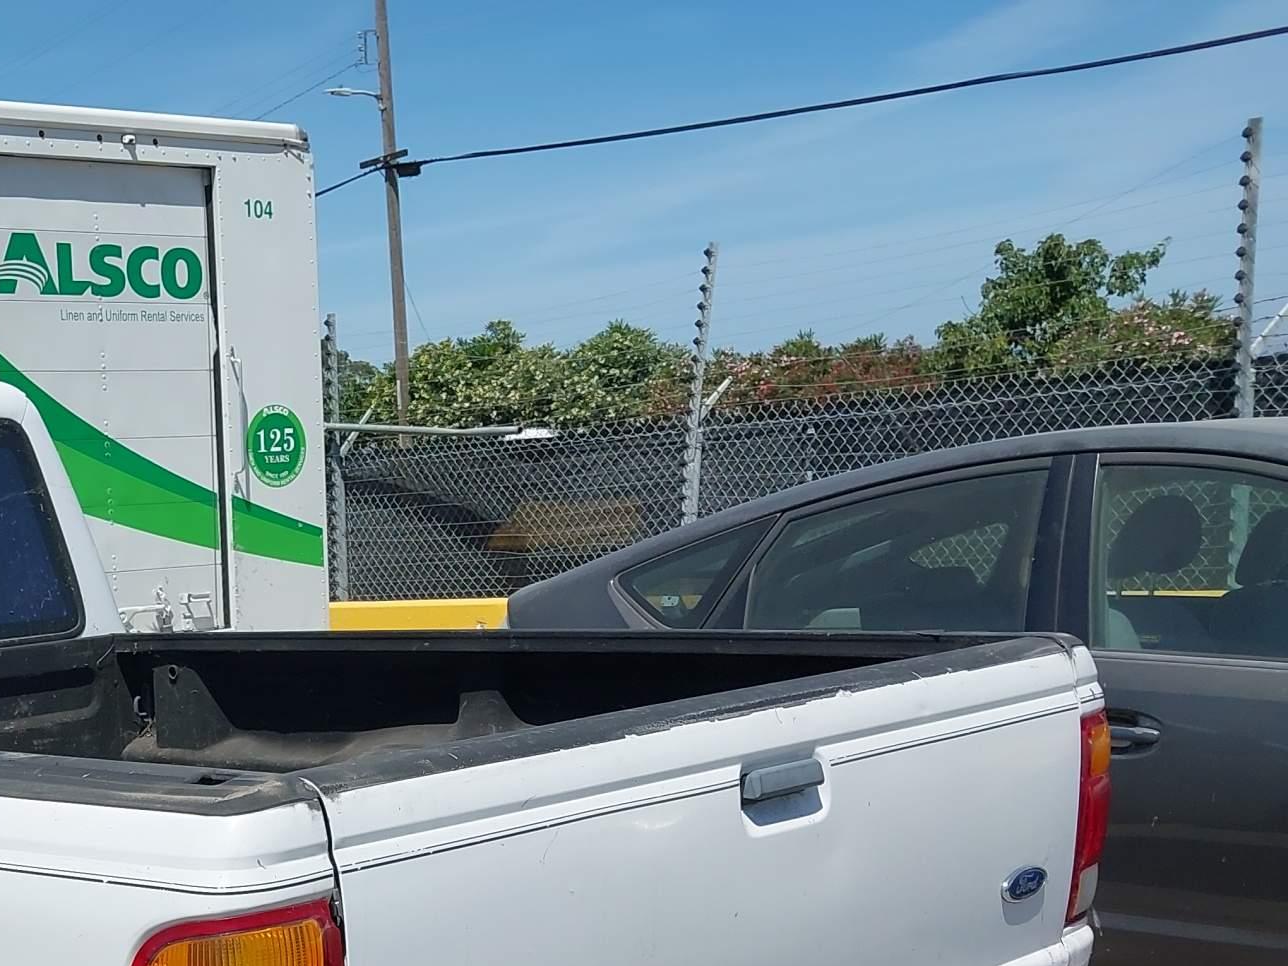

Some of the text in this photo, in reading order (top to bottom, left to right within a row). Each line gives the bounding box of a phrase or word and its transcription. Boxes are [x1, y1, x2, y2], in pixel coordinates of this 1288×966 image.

[244, 199, 273, 219] 104
[60, 309, 205, 322] Linen and Uniform Rental Services
[256, 428, 295, 453] 125
[264, 454, 290, 464] YEARS
